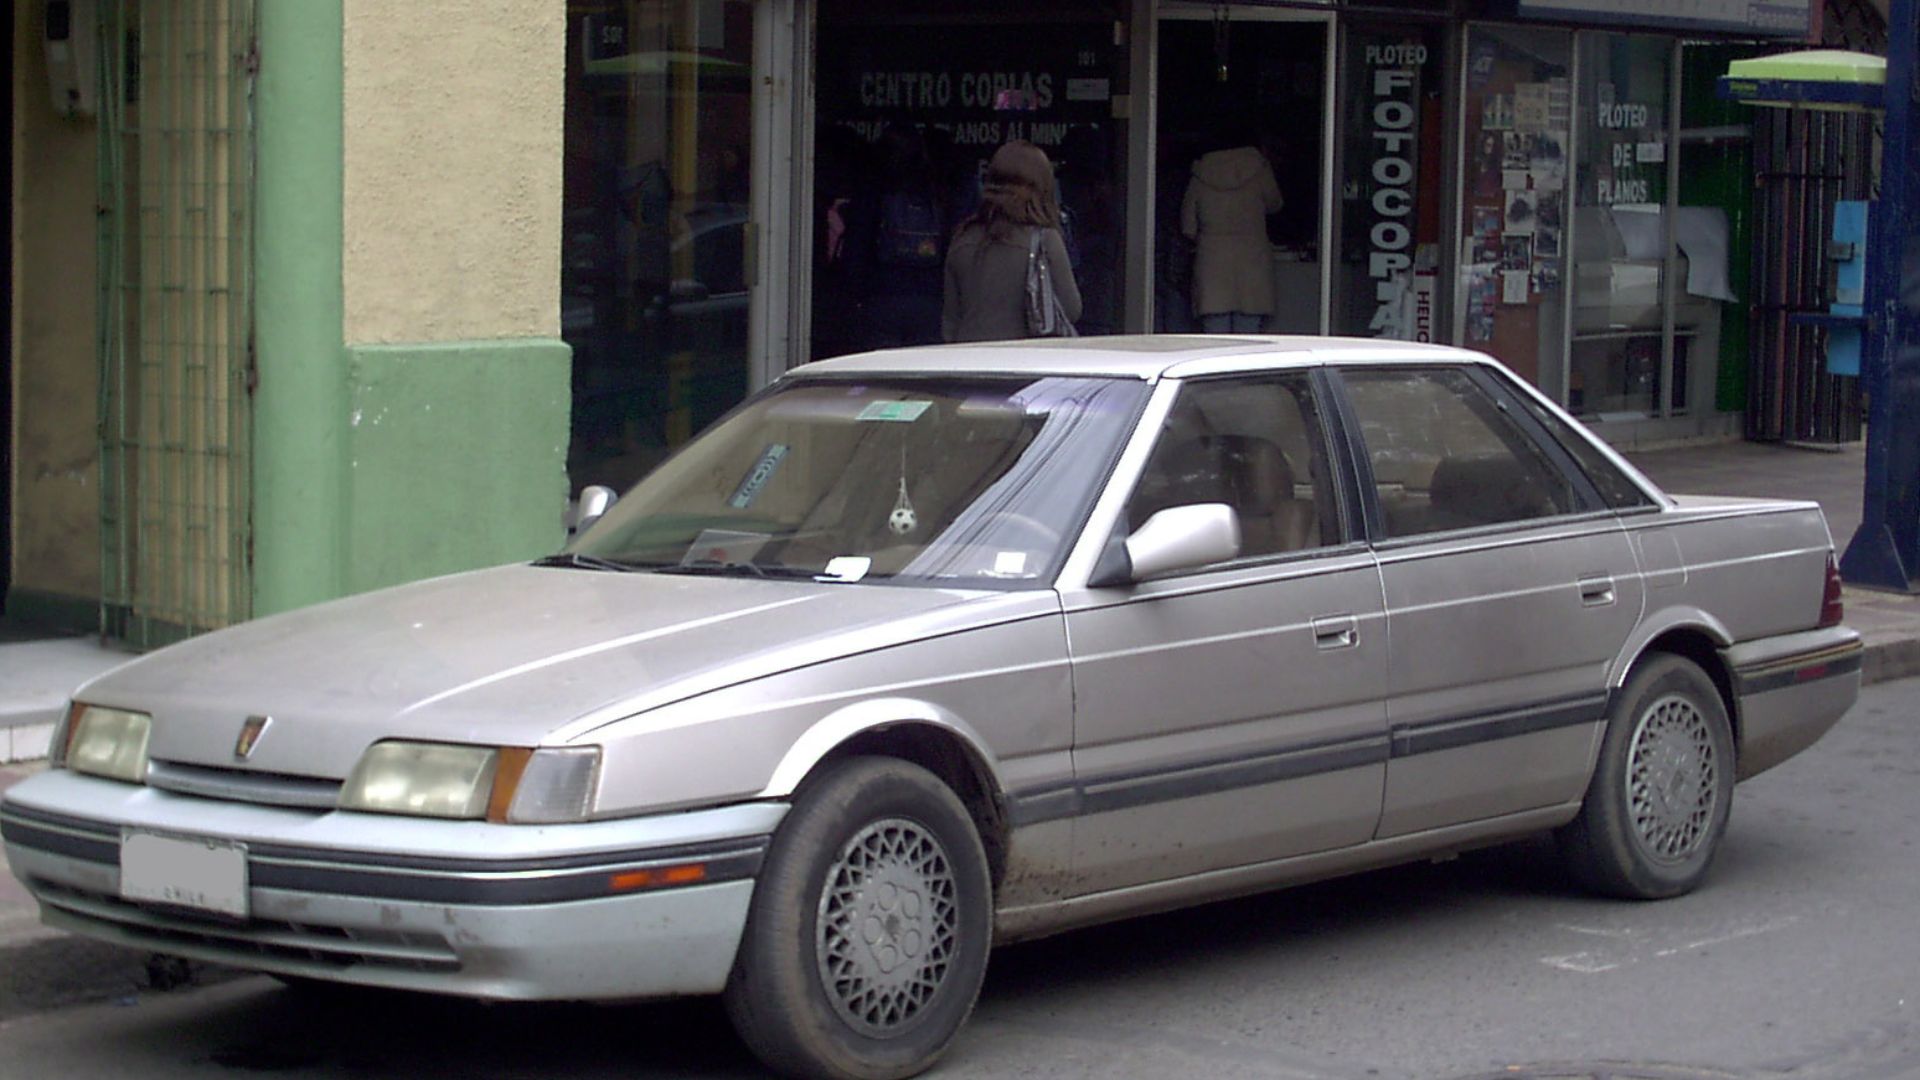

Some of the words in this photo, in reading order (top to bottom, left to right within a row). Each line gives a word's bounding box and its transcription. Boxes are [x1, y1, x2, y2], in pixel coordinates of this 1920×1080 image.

[1365, 45, 1428, 65] PLOTEO
[860, 71, 952, 108] CENTRO
[960, 71, 1054, 109] COPIAS
[1597, 103, 1647, 128] PLOTEO
[1612, 142, 1632, 168] DE
[1597, 178, 1647, 203] PLANOS
